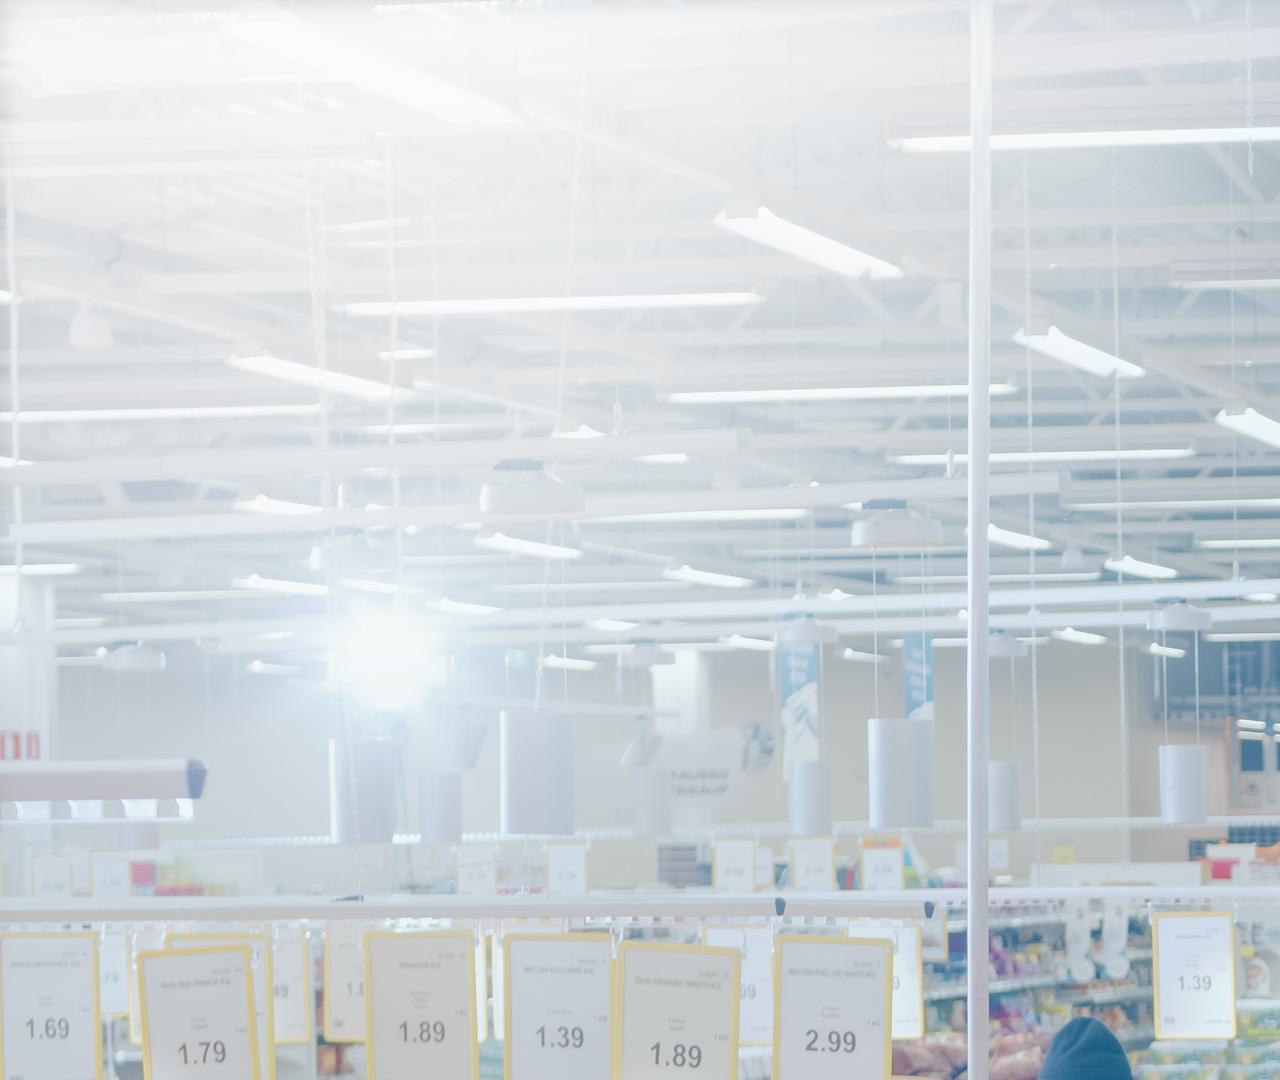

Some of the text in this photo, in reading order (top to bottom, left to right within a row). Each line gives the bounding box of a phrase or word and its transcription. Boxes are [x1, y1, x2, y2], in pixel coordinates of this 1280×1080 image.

[1177, 975, 1212, 991] 1.39
[25, 1017, 70, 1040] 1.69
[399, 1020, 446, 1043] 1.89
[536, 1025, 584, 1049] 1.39
[178, 1040, 226, 1065] 1.79
[805, 1029, 856, 1053] 2.99
[650, 1041, 702, 1069] 1.89
